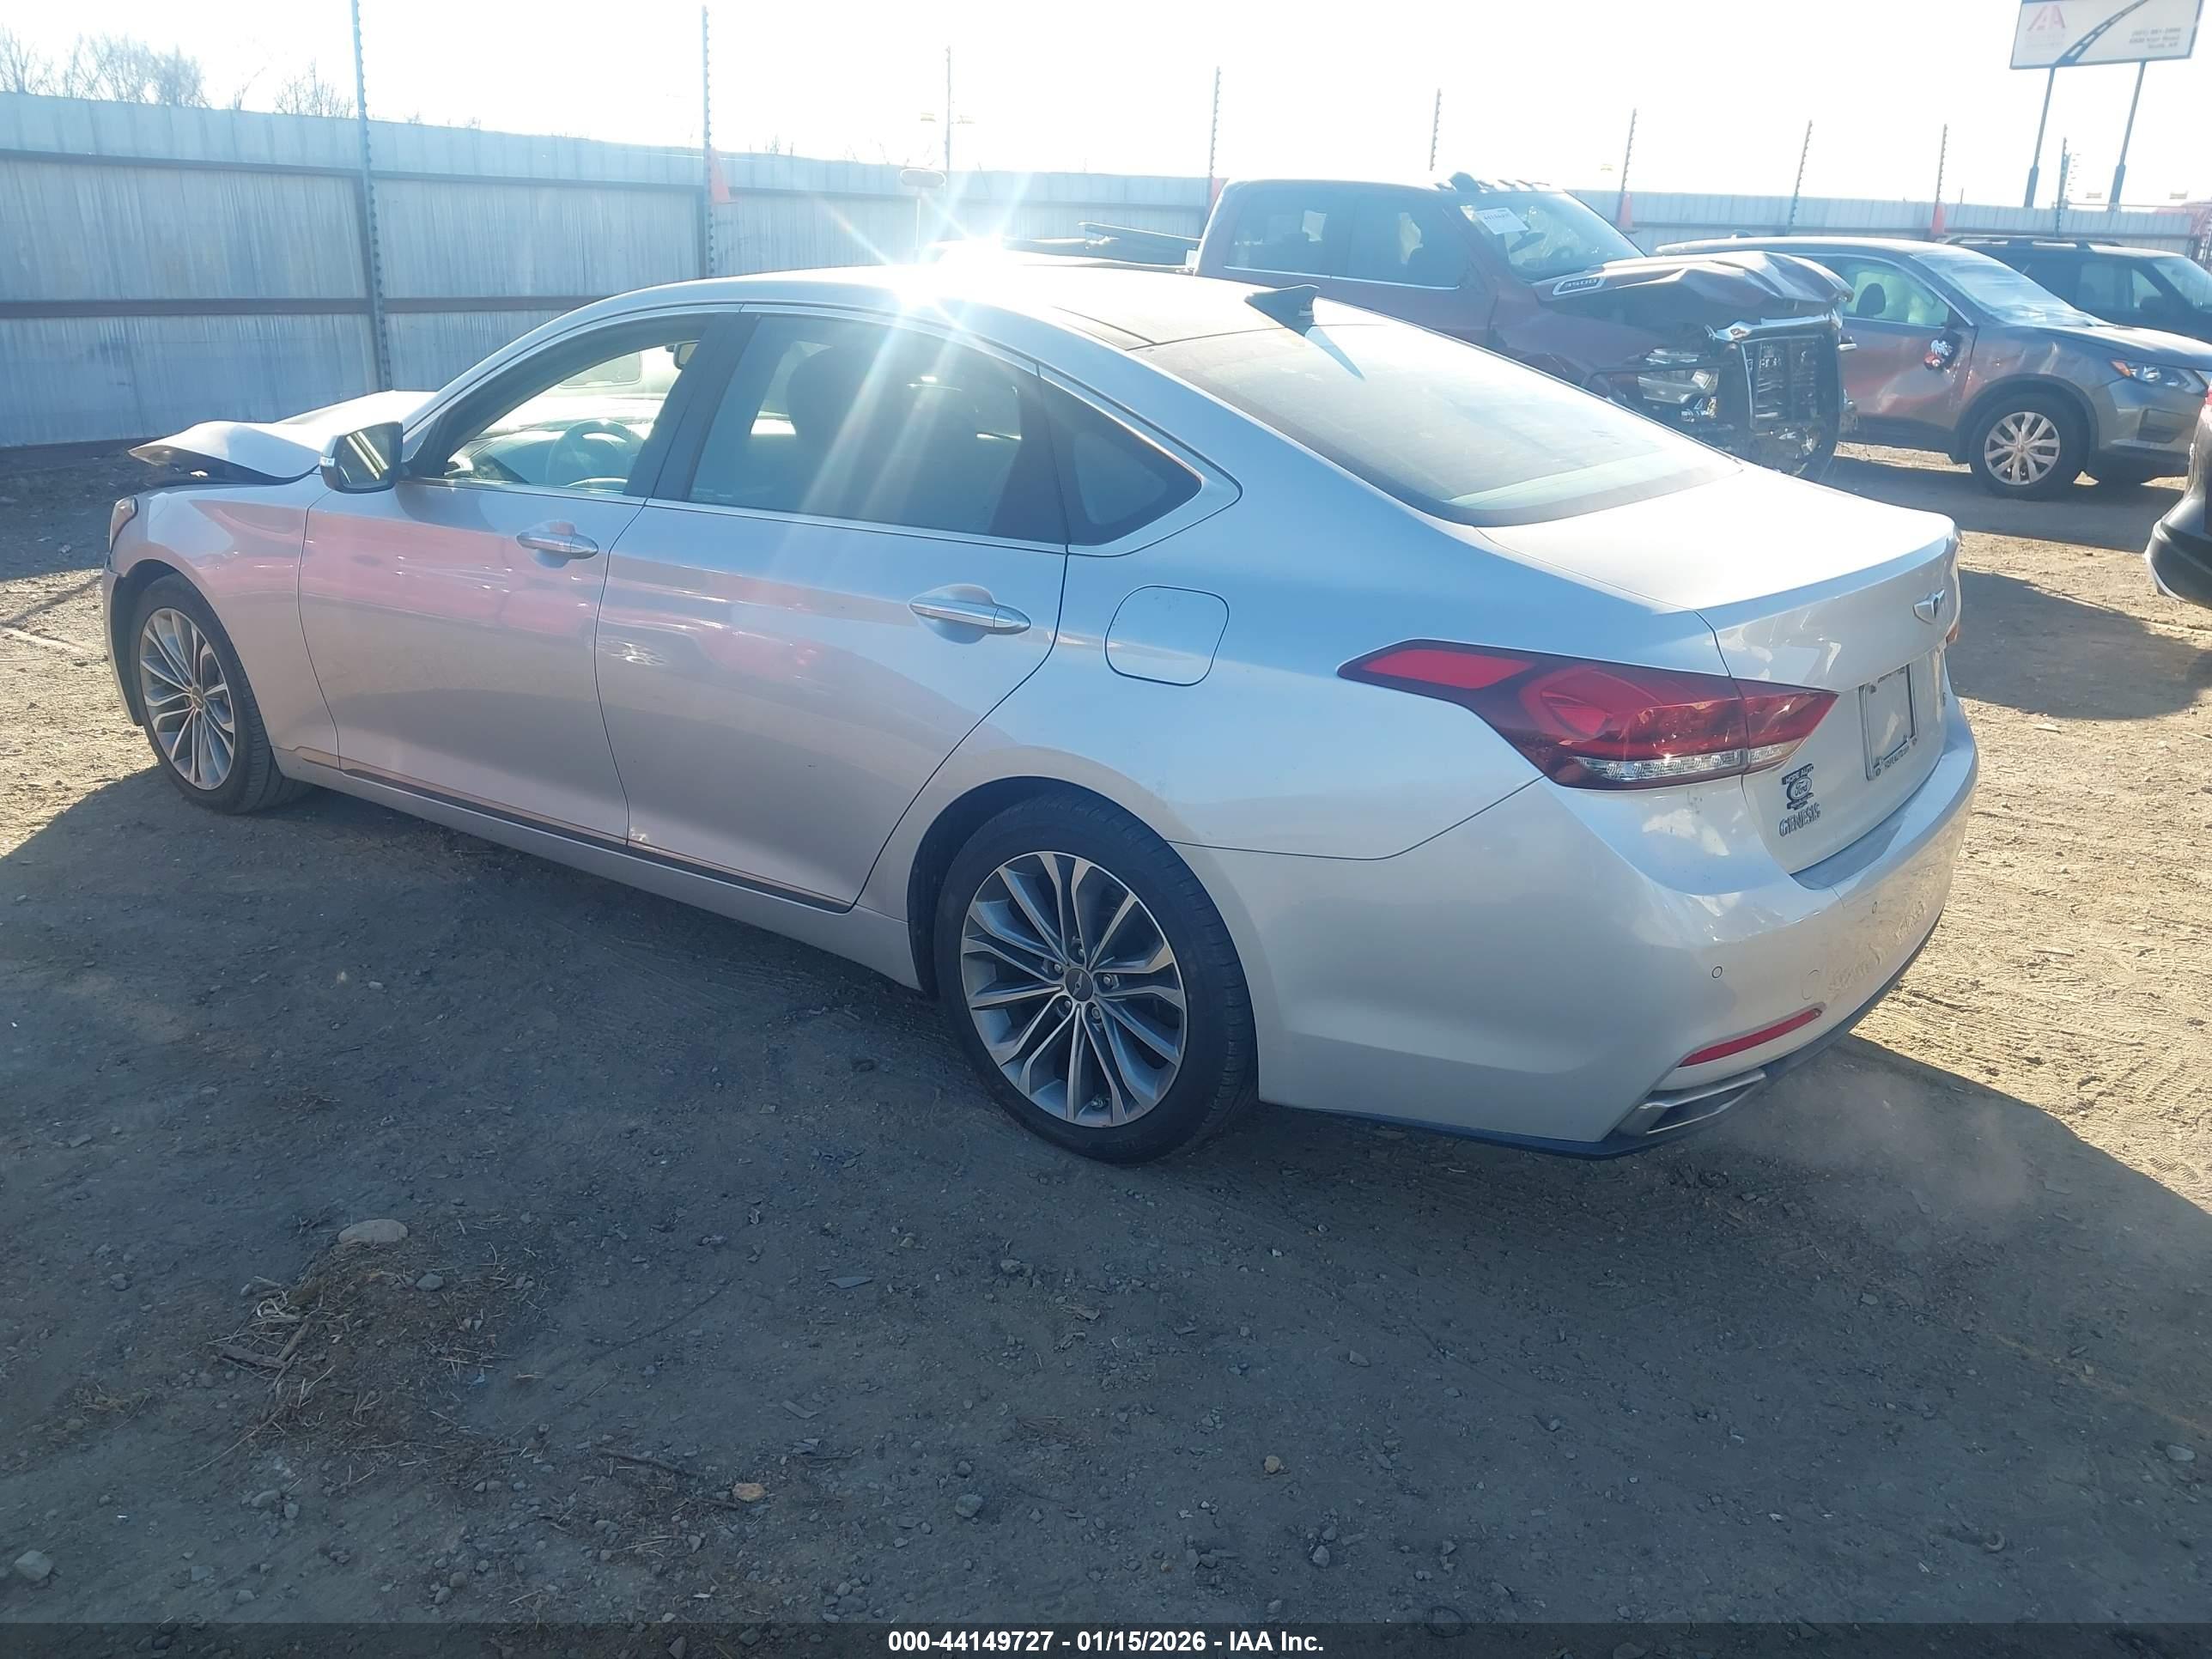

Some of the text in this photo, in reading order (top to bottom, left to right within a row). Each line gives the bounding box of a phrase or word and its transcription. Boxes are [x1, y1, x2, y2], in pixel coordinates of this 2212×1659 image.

[1564, 279, 1597, 289] 3500
[1794, 780, 1808, 796] Ford
[1779, 802, 1820, 837] GENESIS
